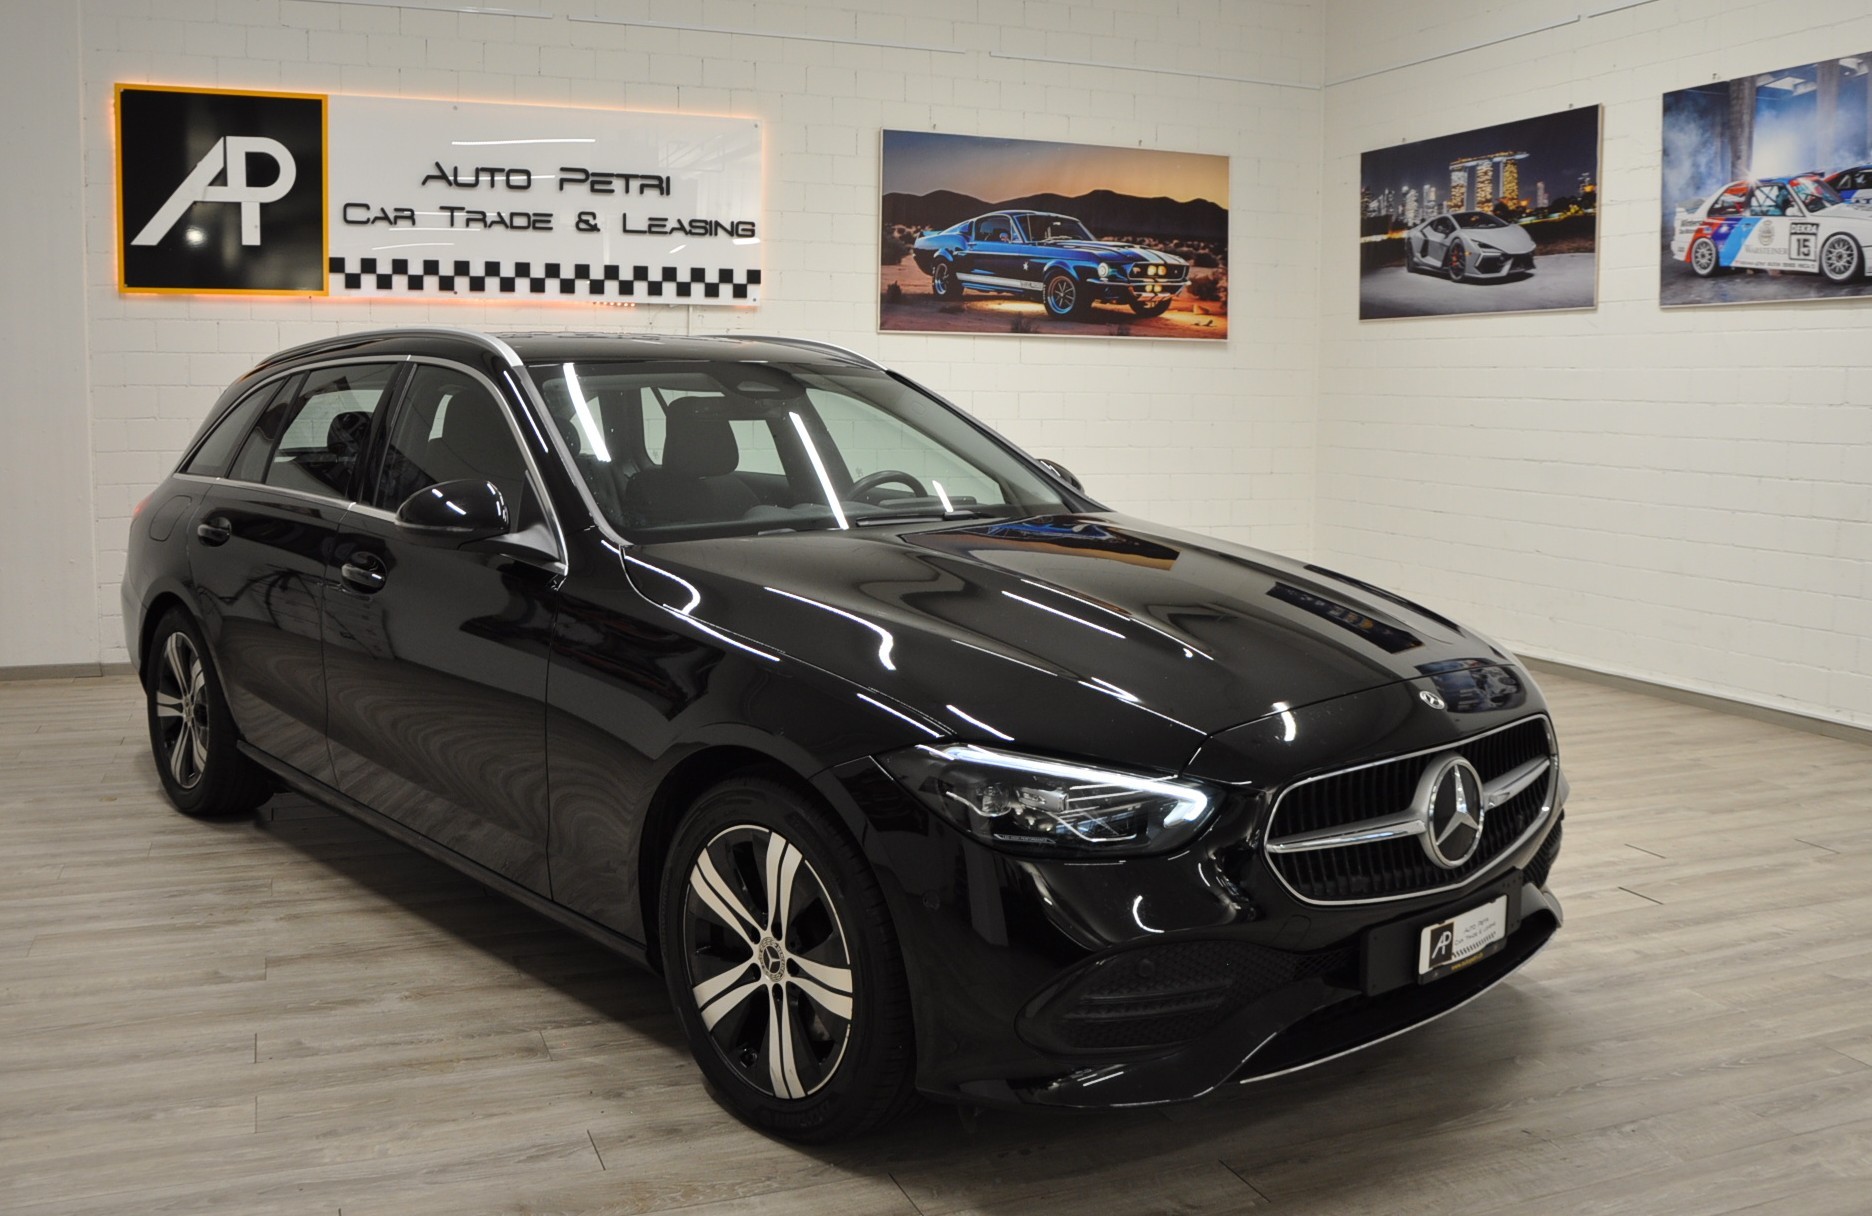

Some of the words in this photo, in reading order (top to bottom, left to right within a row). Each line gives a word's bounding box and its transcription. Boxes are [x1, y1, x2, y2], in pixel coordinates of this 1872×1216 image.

[131, 136, 296, 246] AP
[421, 161, 532, 190] AUTO
[559, 167, 671, 196] PETRI
[343, 202, 416, 226] CAR
[439, 205, 553, 231] TRADE
[575, 211, 600, 232] &
[622, 212, 755, 238] LEASING
[1796, 238, 1811, 257] 15
[1431, 931, 1452, 959] AP
